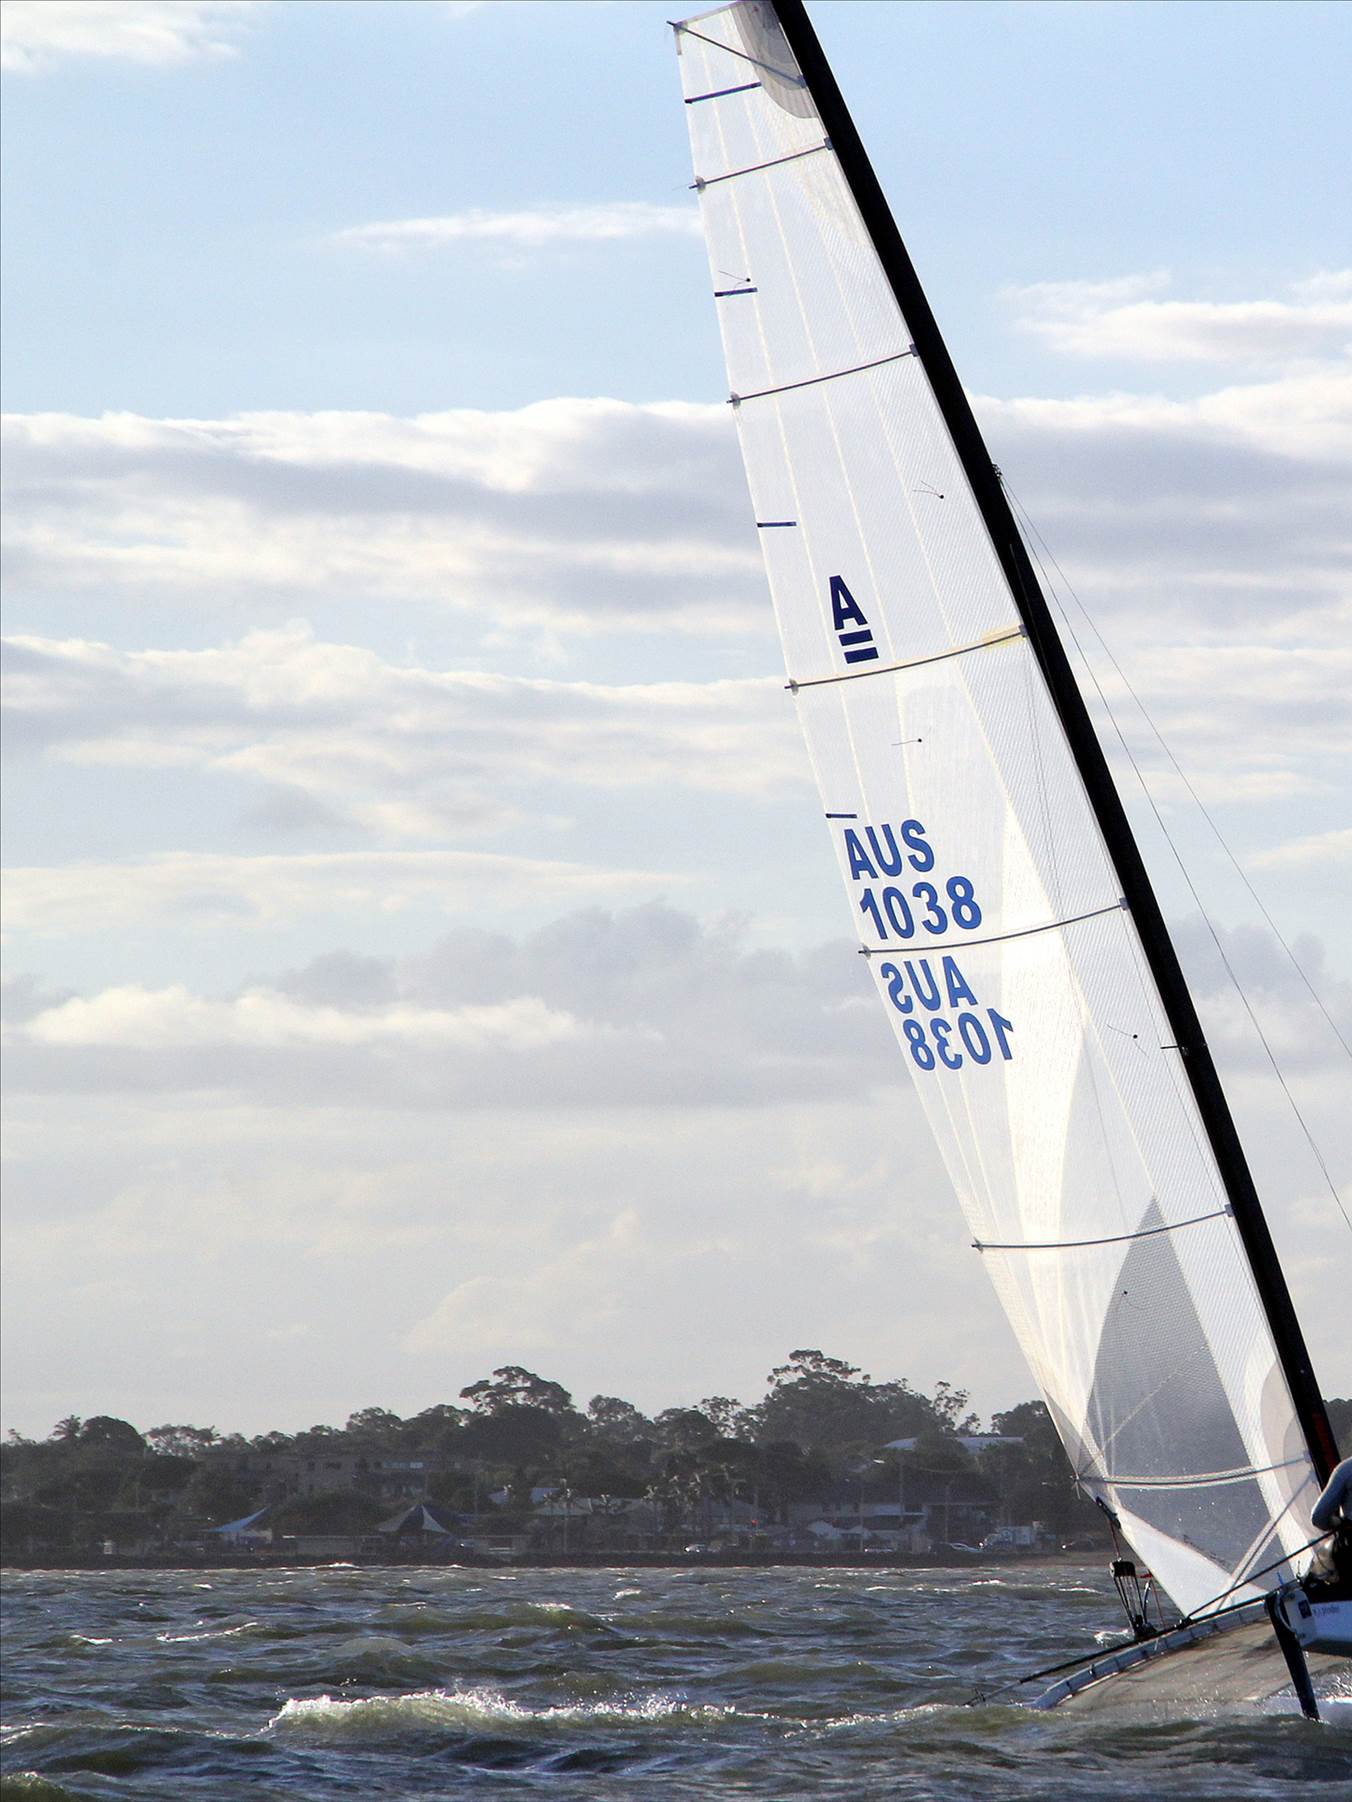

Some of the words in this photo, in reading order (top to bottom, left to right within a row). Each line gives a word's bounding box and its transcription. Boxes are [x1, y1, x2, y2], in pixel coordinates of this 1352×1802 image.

[829, 575, 868, 630] A
[844, 819, 935, 880] AUS
[860, 875, 982, 940] 1038
